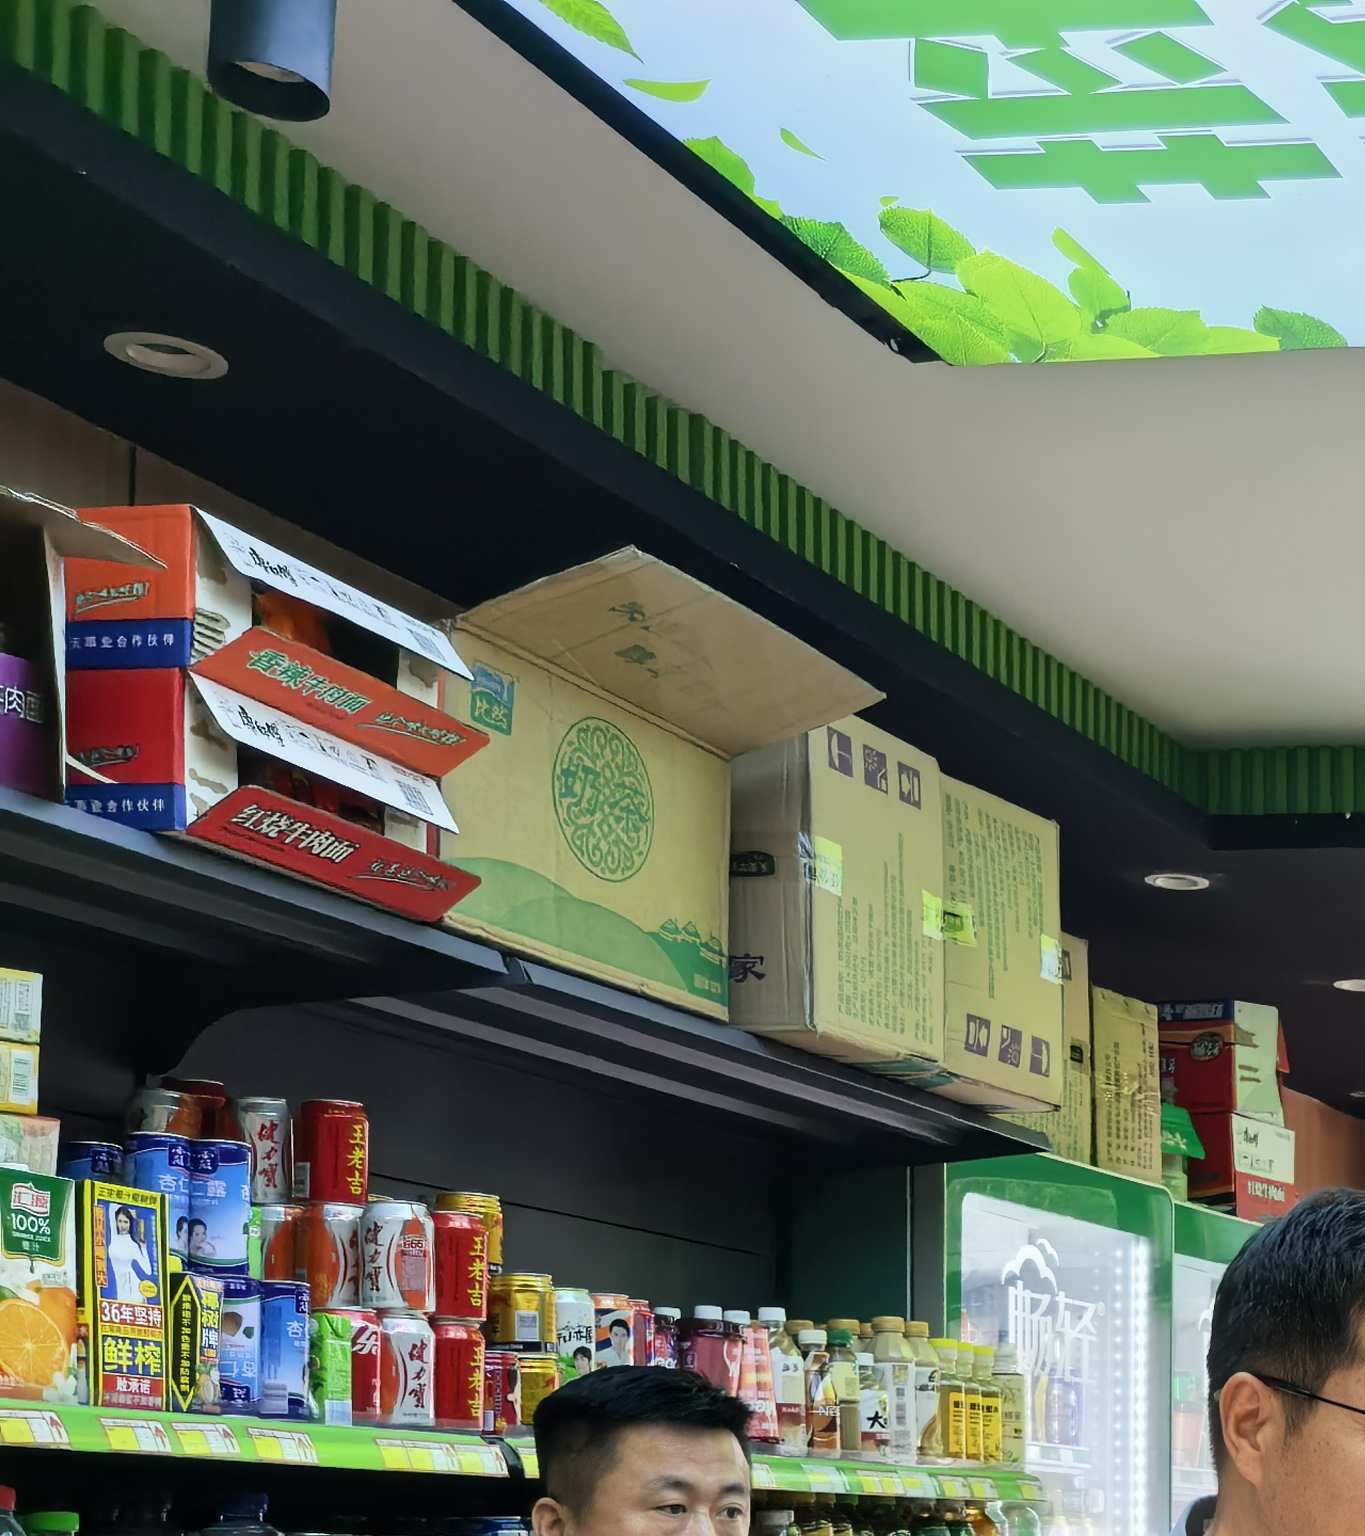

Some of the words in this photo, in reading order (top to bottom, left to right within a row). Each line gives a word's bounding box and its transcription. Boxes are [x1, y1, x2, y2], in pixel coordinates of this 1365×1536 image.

[0, 683, 43, 722] 肉面
[247, 648, 371, 713] 香辣牛肉面
[230, 805, 358, 863] 红烧牛肉面
[347, 1124, 365, 1195] 王老吉
[11, 1214, 51, 1233] 100%
[467, 1236, 484, 1307] 王老吉
[104, 1337, 163, 1375] 鲜榨
[468, 1347, 483, 1418] 王老吉
